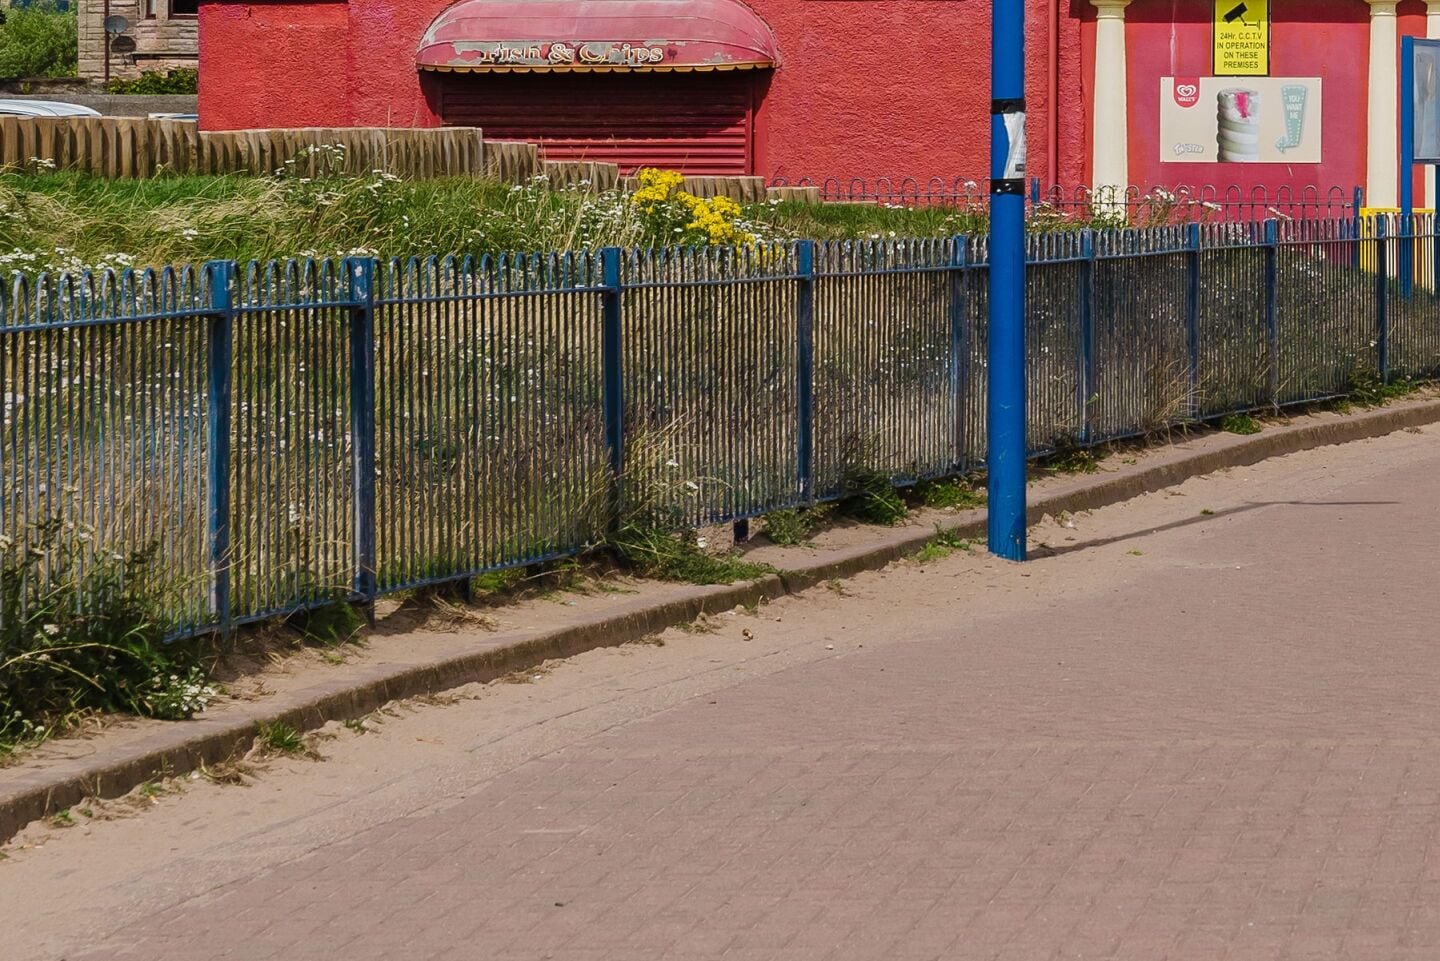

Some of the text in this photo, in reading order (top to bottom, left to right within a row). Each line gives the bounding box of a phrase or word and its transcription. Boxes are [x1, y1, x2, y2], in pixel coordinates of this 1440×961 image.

[1217, 41, 1265, 50] IN OPERATION
[549, 43, 575, 63] &
[1223, 51, 1259, 59] ON THESE
[1223, 60, 1259, 69] PREMISES
[1288, 95, 1300, 103] YOU
[1286, 103, 1302, 111] WANT
[1289, 111, 1299, 119] ME
